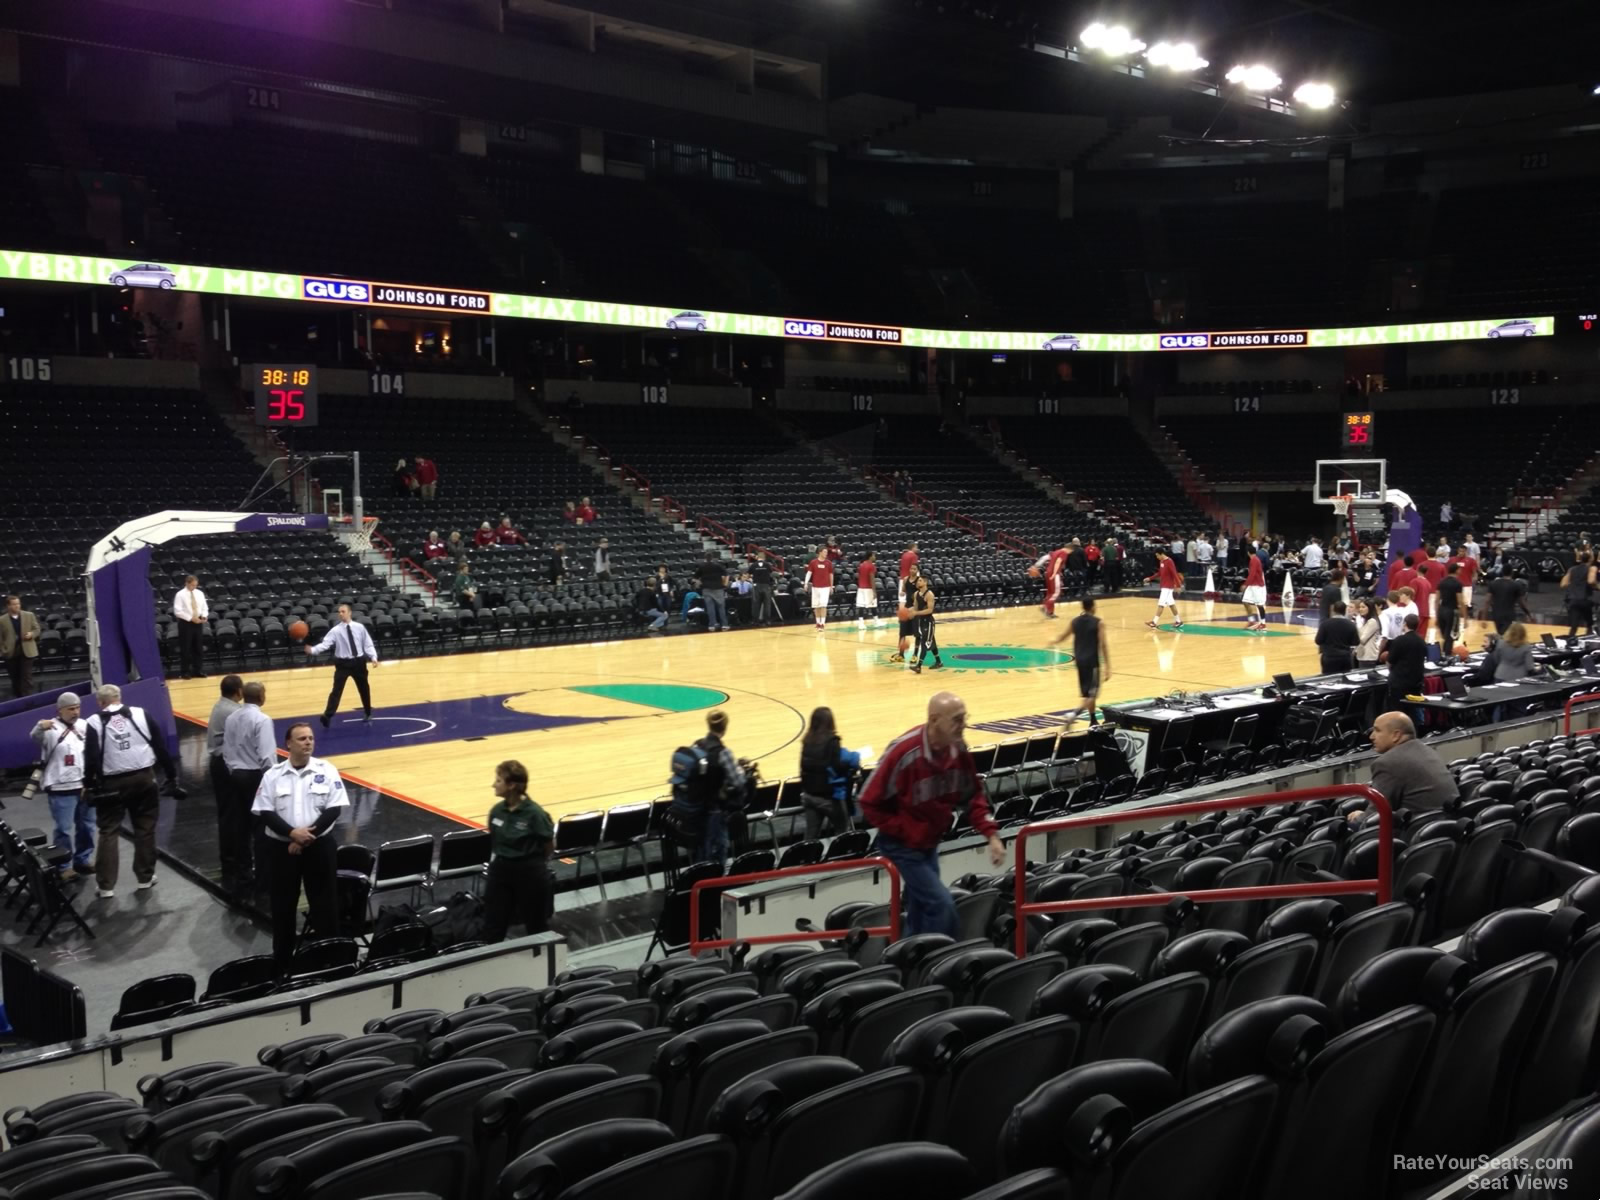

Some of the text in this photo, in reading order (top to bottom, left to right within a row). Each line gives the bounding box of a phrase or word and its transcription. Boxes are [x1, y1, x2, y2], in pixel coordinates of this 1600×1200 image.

[248, 88, 280, 109] 204
[224, 270, 296, 298] MPG
[306, 281, 485, 308] GUS JOHNSON FORD
[736, 315, 779, 336] MPG
[785, 322, 899, 341] GUS JOHNSON FORD
[1108, 335, 1153, 351] MPG
[1161, 334, 1304, 347] GUS JOHNSON FORD
[9, 358, 51, 381] 105
[262, 369, 310, 385] 38:18
[371, 374, 403, 393] 104
[643, 386, 668, 404] 103
[853, 395, 873, 411] 102
[1491, 388, 1520, 405] 123
[268, 390, 306, 420] 35
[1038, 399, 1059, 414] 101
[1234, 397, 1260, 412] 124
[1349, 426, 1369, 443] 35
[267, 516, 306, 526] SPALDING
